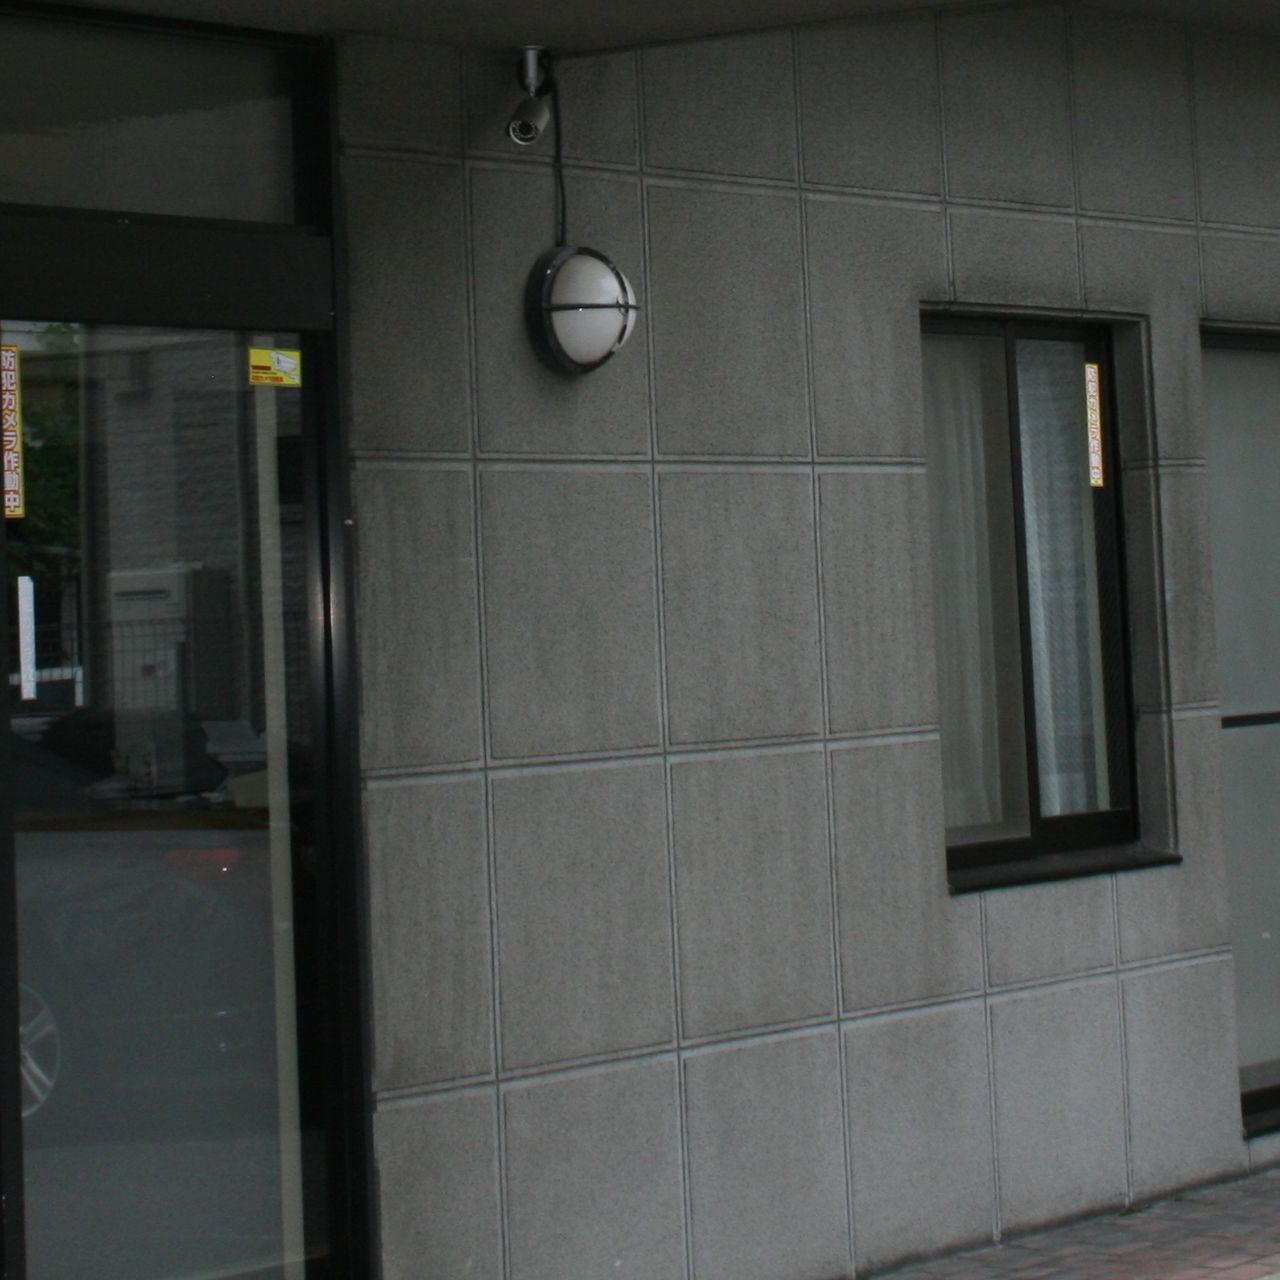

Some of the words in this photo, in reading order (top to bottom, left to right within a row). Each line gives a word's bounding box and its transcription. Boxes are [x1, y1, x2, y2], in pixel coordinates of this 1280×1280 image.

[1, 350, 20, 513] 防犯カメラ作動中
